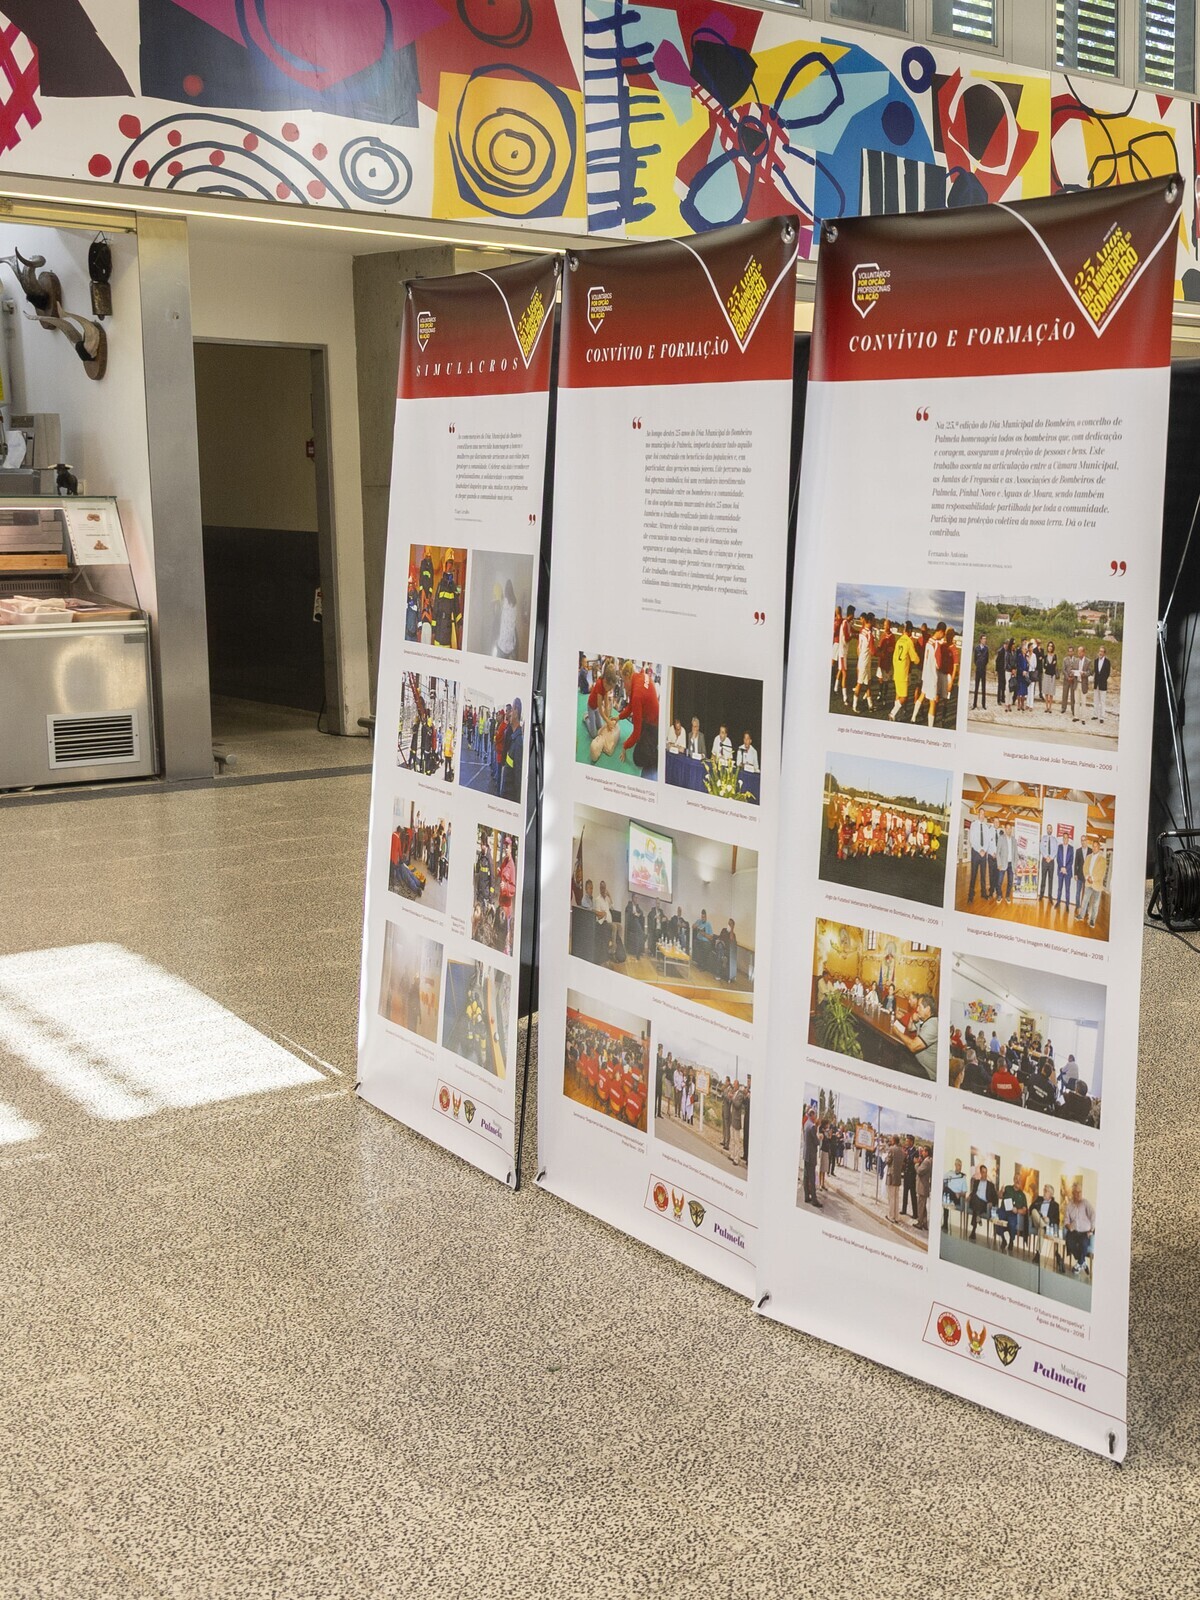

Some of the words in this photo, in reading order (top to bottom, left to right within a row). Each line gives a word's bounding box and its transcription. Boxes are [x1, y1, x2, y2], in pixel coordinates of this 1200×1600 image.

[858, 270, 891, 279] VOLUNTÁRIOS
[1075, 258, 1095, 296] 25
[1080, 286, 1096, 307] DIA
[1092, 238, 1130, 290] MUNICIPAL
[857, 285, 891, 294] PROFISSIONAIS
[868, 278, 886, 287] OPÇÃO
[1088, 246, 1138, 322] BOMBEIRO
[865, 292, 880, 300] AÇÃO
[736, 276, 768, 340] BOMBEIRO
[849, 329, 938, 352] CONVÍVIO
[946, 330, 958, 347] E
[966, 318, 1075, 346] FORMAÇÃO
[586, 343, 643, 363] CONVÍVIO
[648, 345, 656, 360] E
[660, 336, 729, 359] FORMAÇÃO
[934, 434, 960, 442] Palmela
[960, 434, 998, 444] homenageia
[998, 434, 1014, 442] todos
[1024, 433, 1058, 442] bombeiros
[1058, 435, 1070, 443] que,
[1085, 432, 1123, 442] dedicação
[934, 462, 959, 470] trabalho
[960, 462, 982, 470] assenta
[992, 461, 1030, 470] articulação
[1053, 461, 1078, 470] Câmara
[1078, 460, 1120, 471] Municipal,
[932, 488, 958, 496] Palmela,
[959, 488, 980, 496] Pinhal
[980, 488, 996, 497] Novo
[1002, 486, 1022, 498] Águas
[1023, 490, 1031, 498] de
[1032, 490, 1054, 498] Moura,
[1055, 490, 1074, 498] sendo
[1074, 490, 1104, 499] também
[946, 502, 996, 512] responsabilidade
[996, 502, 1030, 512] partilhada
[1032, 504, 1042, 514] por
[1044, 504, 1057, 512] toda
[1063, 504, 1110, 514] comunidade.
[930, 514, 958, 524] Participa
[966, 516, 994, 526] proteção
[994, 516, 1020, 525] coletiva
[1020, 516, 1028, 526] da
[1046, 518, 1064, 526] terra.
[1065, 518, 1076, 526] Dá
[1083, 520, 1096, 528] teu
[480, 1118, 502, 1140] Palmela
[714, 1223, 745, 1249] Palmela
[1033, 1361, 1086, 1393] Palmela
